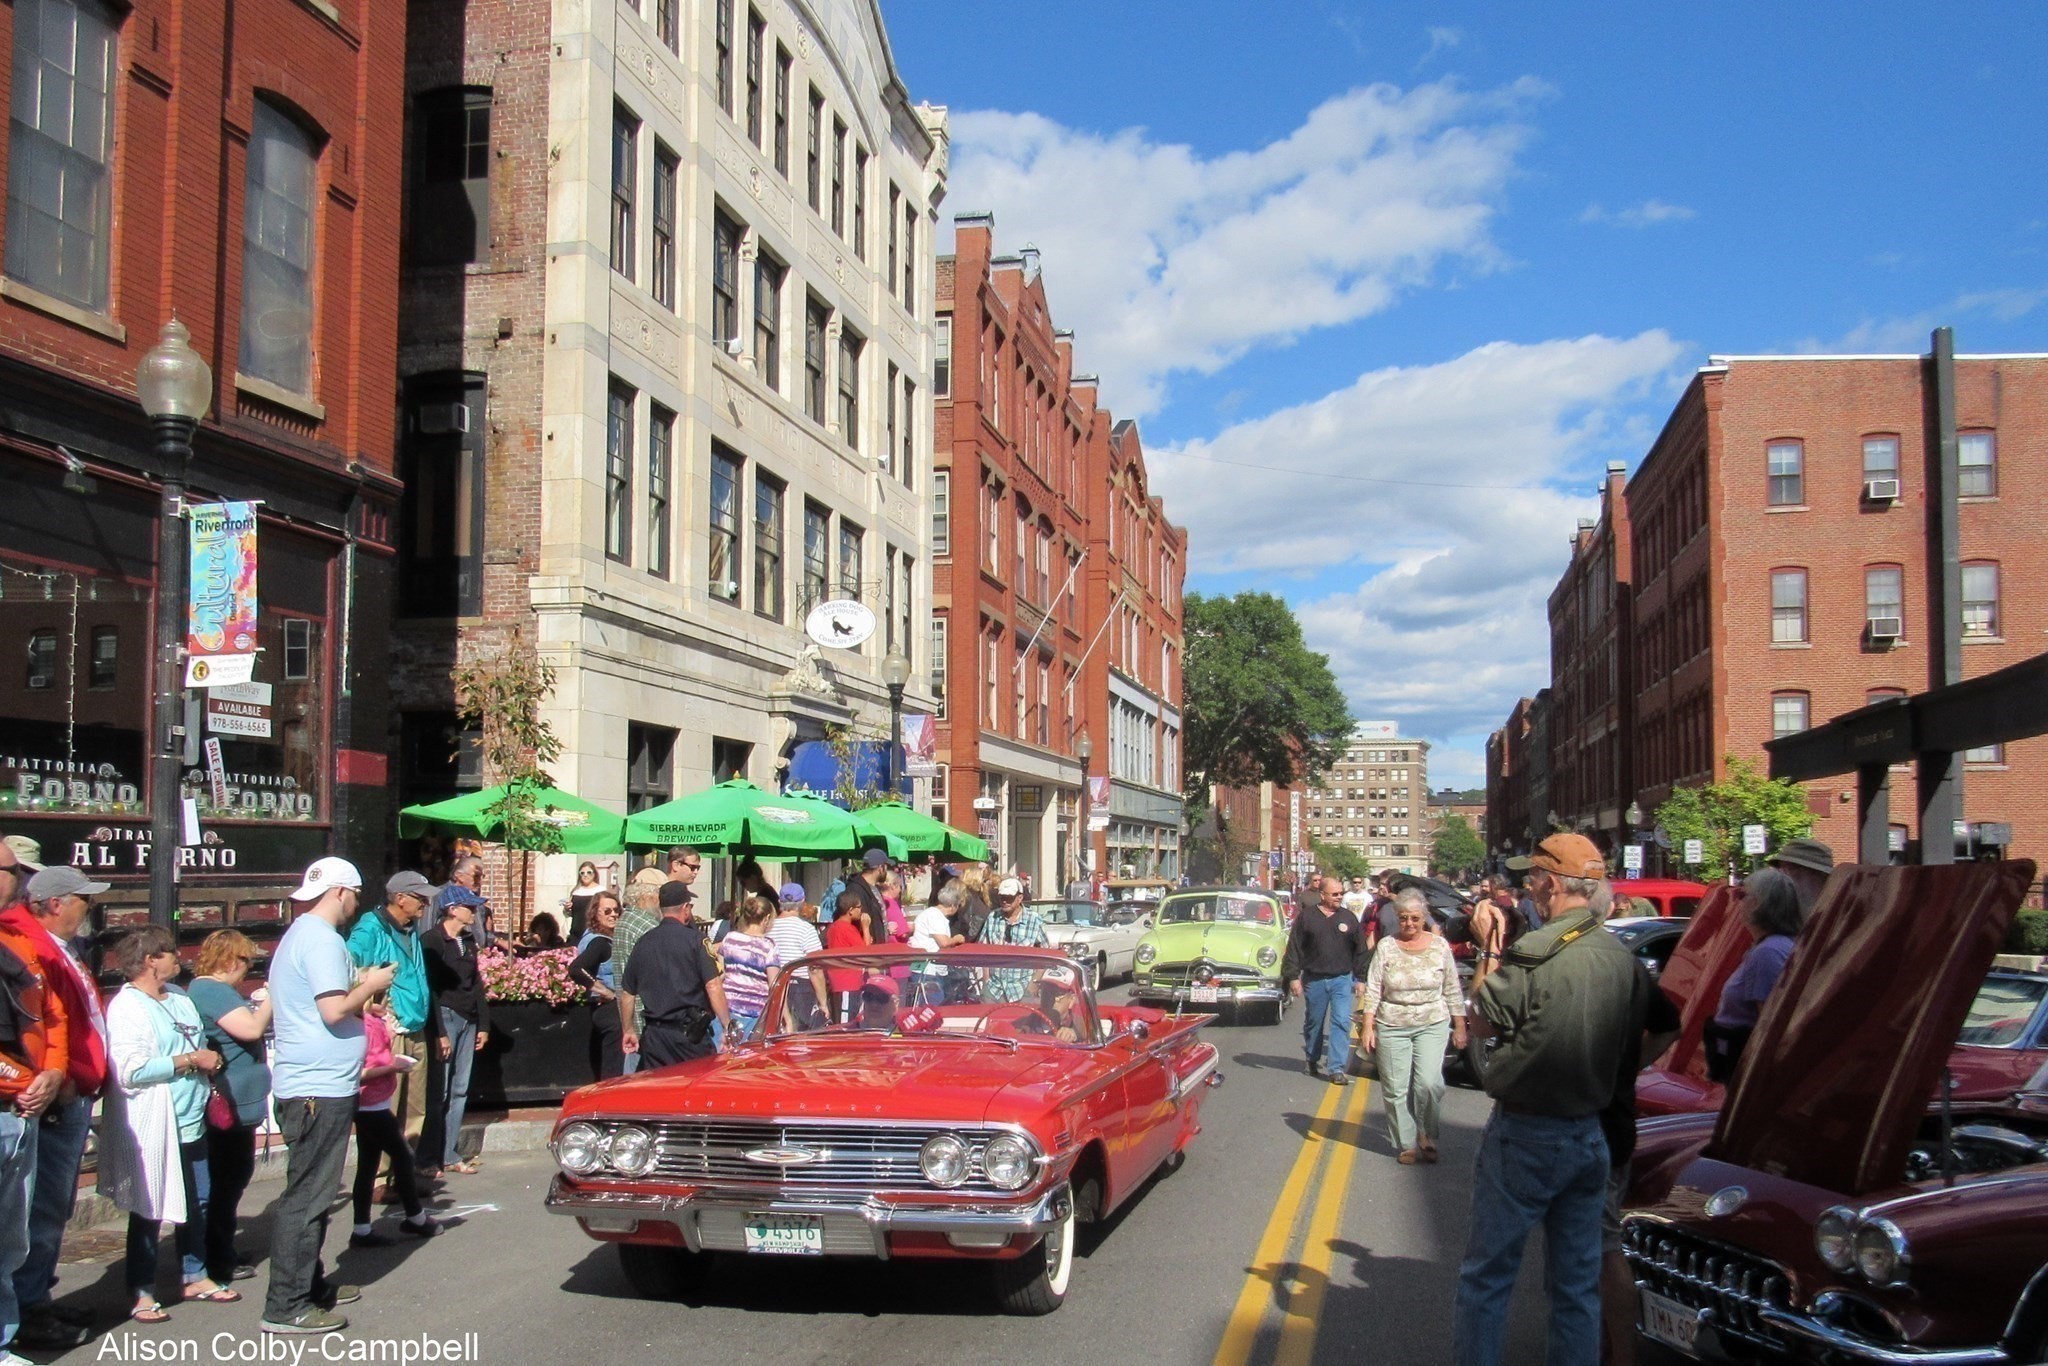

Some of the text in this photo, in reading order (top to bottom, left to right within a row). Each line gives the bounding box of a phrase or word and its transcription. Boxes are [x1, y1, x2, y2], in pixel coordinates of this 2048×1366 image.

[195, 518, 254, 533] Riverfront
[193, 533, 231, 651] Cultural
[837, 608, 859, 616] HOUSE
[849, 602, 864, 613] DOG
[217, 702, 262, 716] AVAILABLE
[213, 717, 267, 733] 978-556-6565
[208, 741, 220, 765] SALE
[0, 754, 97, 775] RATTORIA
[205, 769, 281, 786] TATTORIA
[18, 772, 138, 806] FORNO
[225, 785, 313, 815] FORNO
[649, 823, 727, 833] SIERRA NEVADA
[656, 834, 702, 843] BREWING
[71, 842, 236, 867] AL FRNO
[1078, 888, 1086, 897] P
